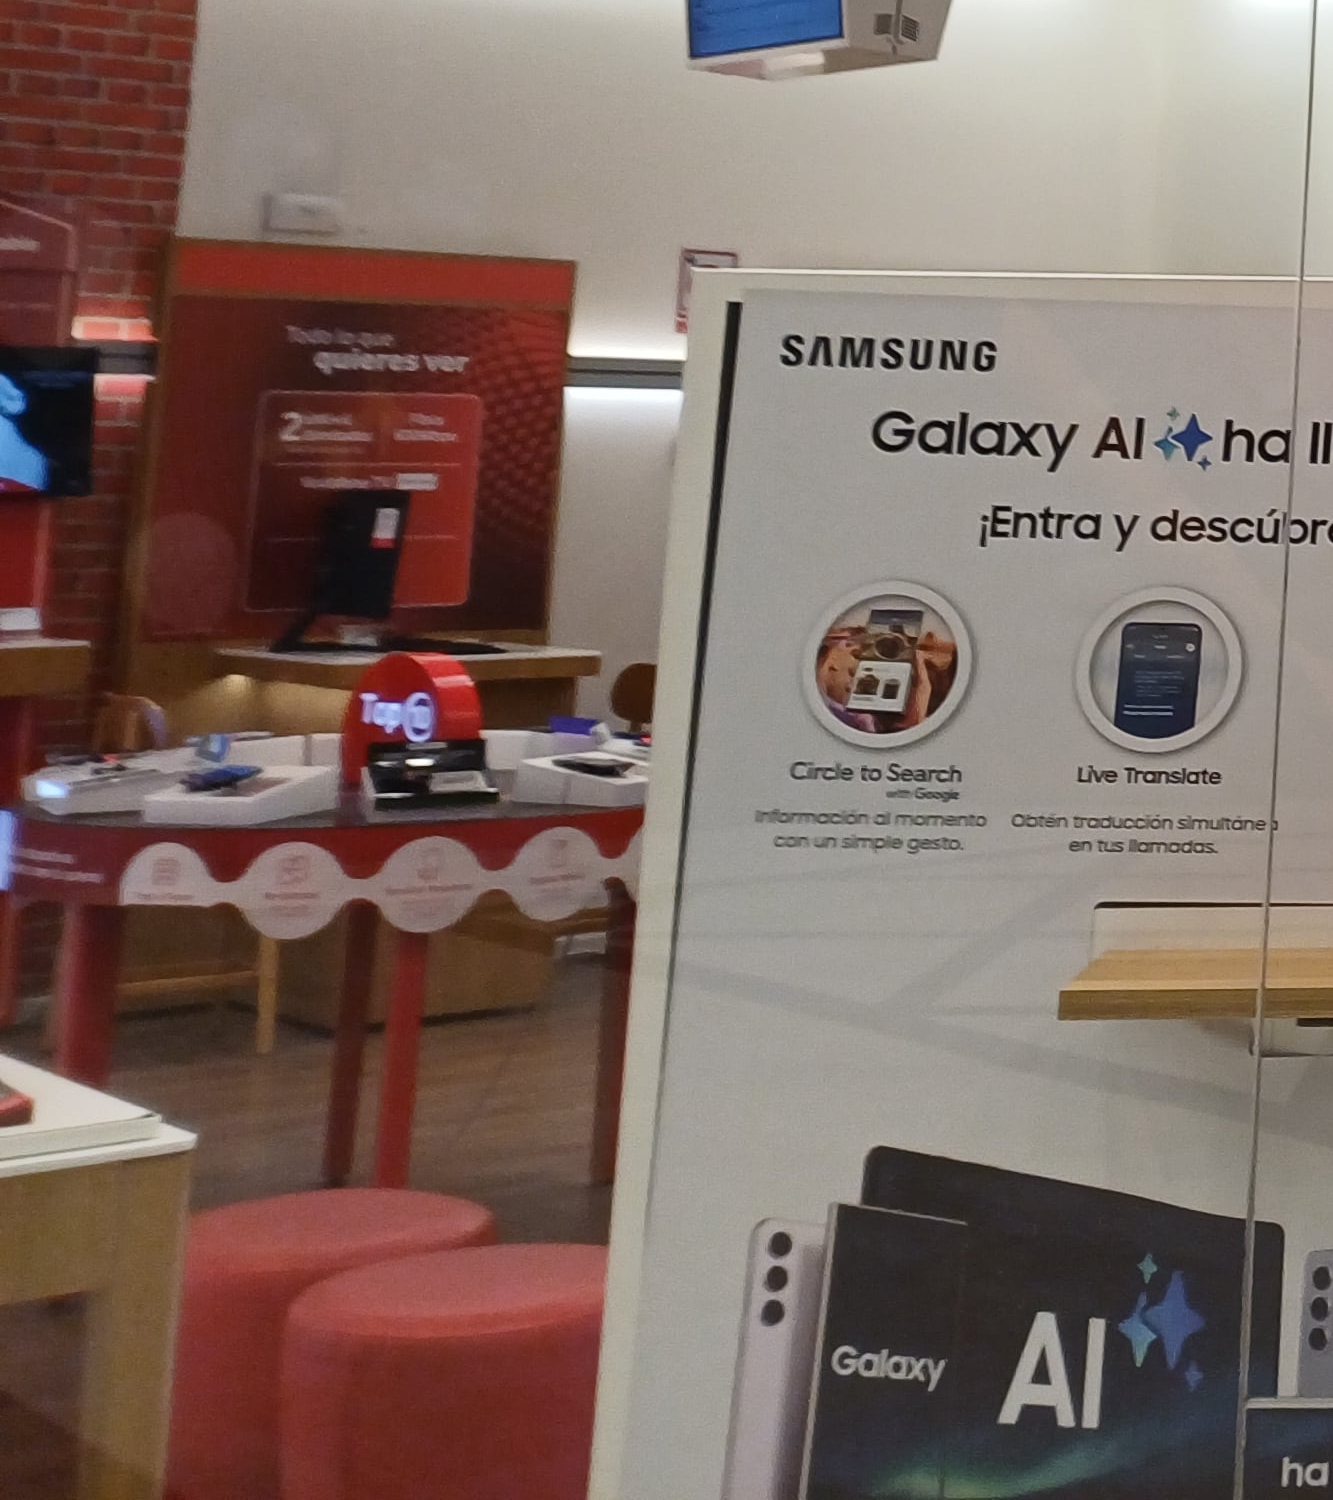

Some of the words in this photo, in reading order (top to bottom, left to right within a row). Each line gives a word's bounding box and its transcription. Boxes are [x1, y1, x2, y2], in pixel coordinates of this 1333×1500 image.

[780, 334, 998, 373] SAMSUNG
[872, 410, 1080, 473] Galaxy
[1091, 416, 1146, 460] AI
[1222, 419, 1291, 463] ha
[978, 505, 1102, 547] ¡Entra
[1113, 513, 1140, 552] y
[789, 761, 854, 781] Circle
[860, 765, 882, 782] to
[885, 763, 962, 783] Search
[1076, 765, 1118, 784] Live
[1123, 766, 1222, 786] Translate
[755, 809, 868, 826] Información
[873, 811, 891, 827] al
[895, 811, 988, 828] momento
[1073, 813, 1173, 831] traducción
[773, 834, 808, 849] con
[813, 835, 837, 849] un
[841, 834, 903, 853] simple
[906, 836, 964, 855] gesto.
[1068, 839, 1093, 853] en
[1096, 838, 1124, 854] tus
[1129, 839, 1219, 855] llamadas.
[831, 1345, 947, 1392] Galaxy
[997, 1311, 1106, 1429] AI
[1280, 1456, 1330, 1488] ha
